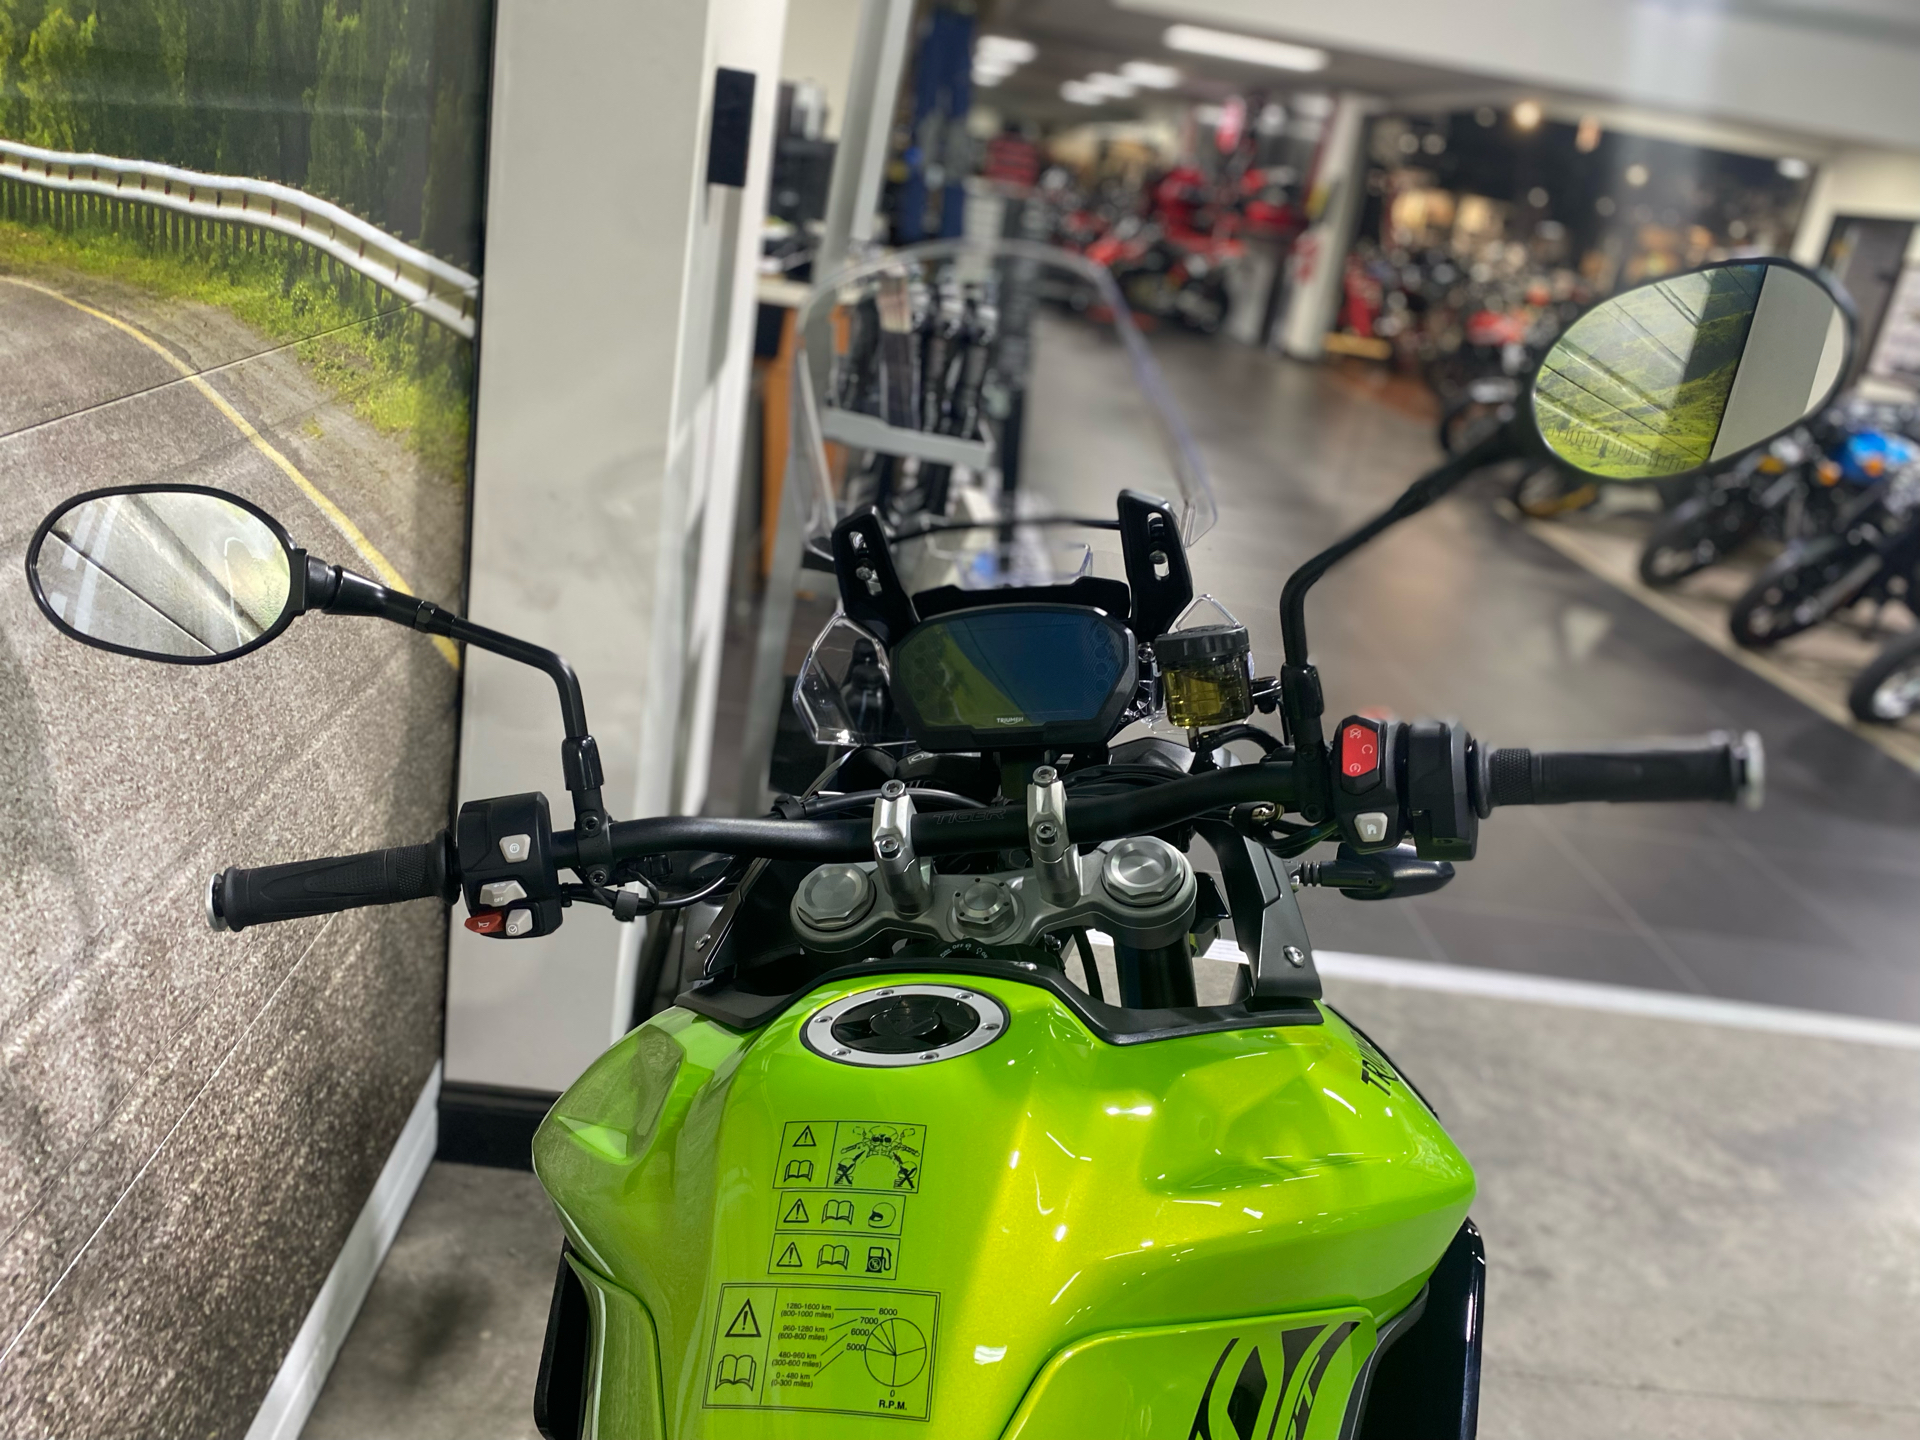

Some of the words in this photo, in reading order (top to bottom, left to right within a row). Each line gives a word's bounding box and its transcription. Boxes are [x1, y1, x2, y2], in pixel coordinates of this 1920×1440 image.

[996, 716, 1024, 725] TRIUMPH
[933, 808, 1007, 825] TIGER
[786, 1302, 820, 1310] 1280-1600
[821, 1303, 832, 1311] km
[780, 1309, 813, 1318] (800-1000
[814, 1311, 834, 1319] miles)
[878, 1307, 898, 1316] 8000
[860, 1316, 879, 1325] 7000
[782, 1324, 813, 1332] 960-1280
[814, 1325, 825, 1333] km
[850, 1327, 870, 1336] 6000
[777, 1332, 807, 1341] (600-800
[807, 1333, 828, 1342] miles)
[846, 1342, 866, 1352] 5000
[778, 1350, 806, 1359] 480-960
[806, 1352, 817, 1360] km
[771, 1358, 801, 1367] (300-600
[801, 1360, 822, 1368] miles)
[775, 1371, 781, 1379] 0
[786, 1372, 799, 1380] 480
[770, 1379, 792, 1387] (0-300
[793, 1380, 813, 1389] miles)
[889, 1389, 896, 1398] 0
[878, 1399, 908, 1410] R.P.M.
